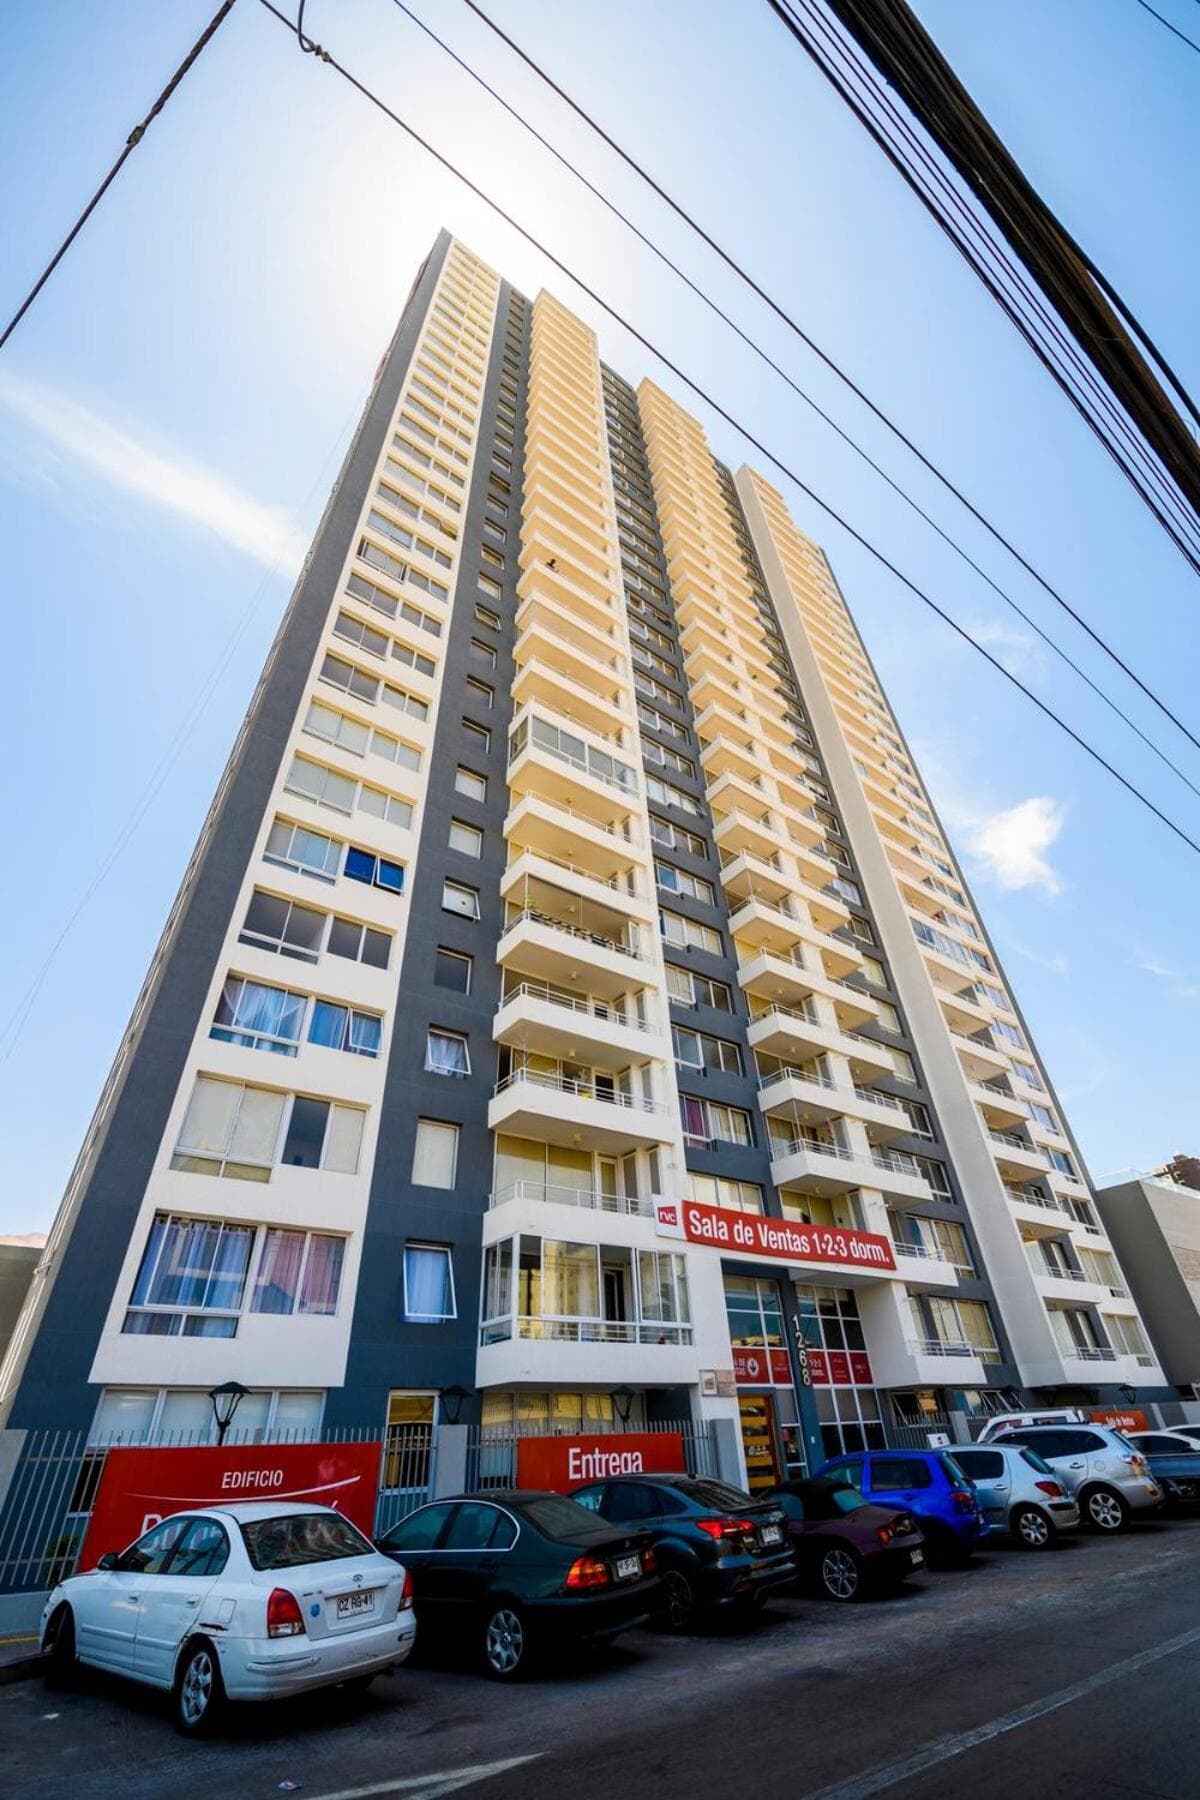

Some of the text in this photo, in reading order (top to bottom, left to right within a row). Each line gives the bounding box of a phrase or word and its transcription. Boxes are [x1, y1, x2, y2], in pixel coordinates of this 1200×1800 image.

[658, 1209, 678, 1225] rvc
[688, 1209, 729, 1241] Sala
[733, 1219, 754, 1244] de
[758, 1223, 811, 1254] Ventas
[849, 1239, 890, 1263] dorm.
[792, 1314, 811, 1386] 1268
[221, 1469, 284, 1489] EDIFICIO
[568, 1447, 643, 1480] Entrega
